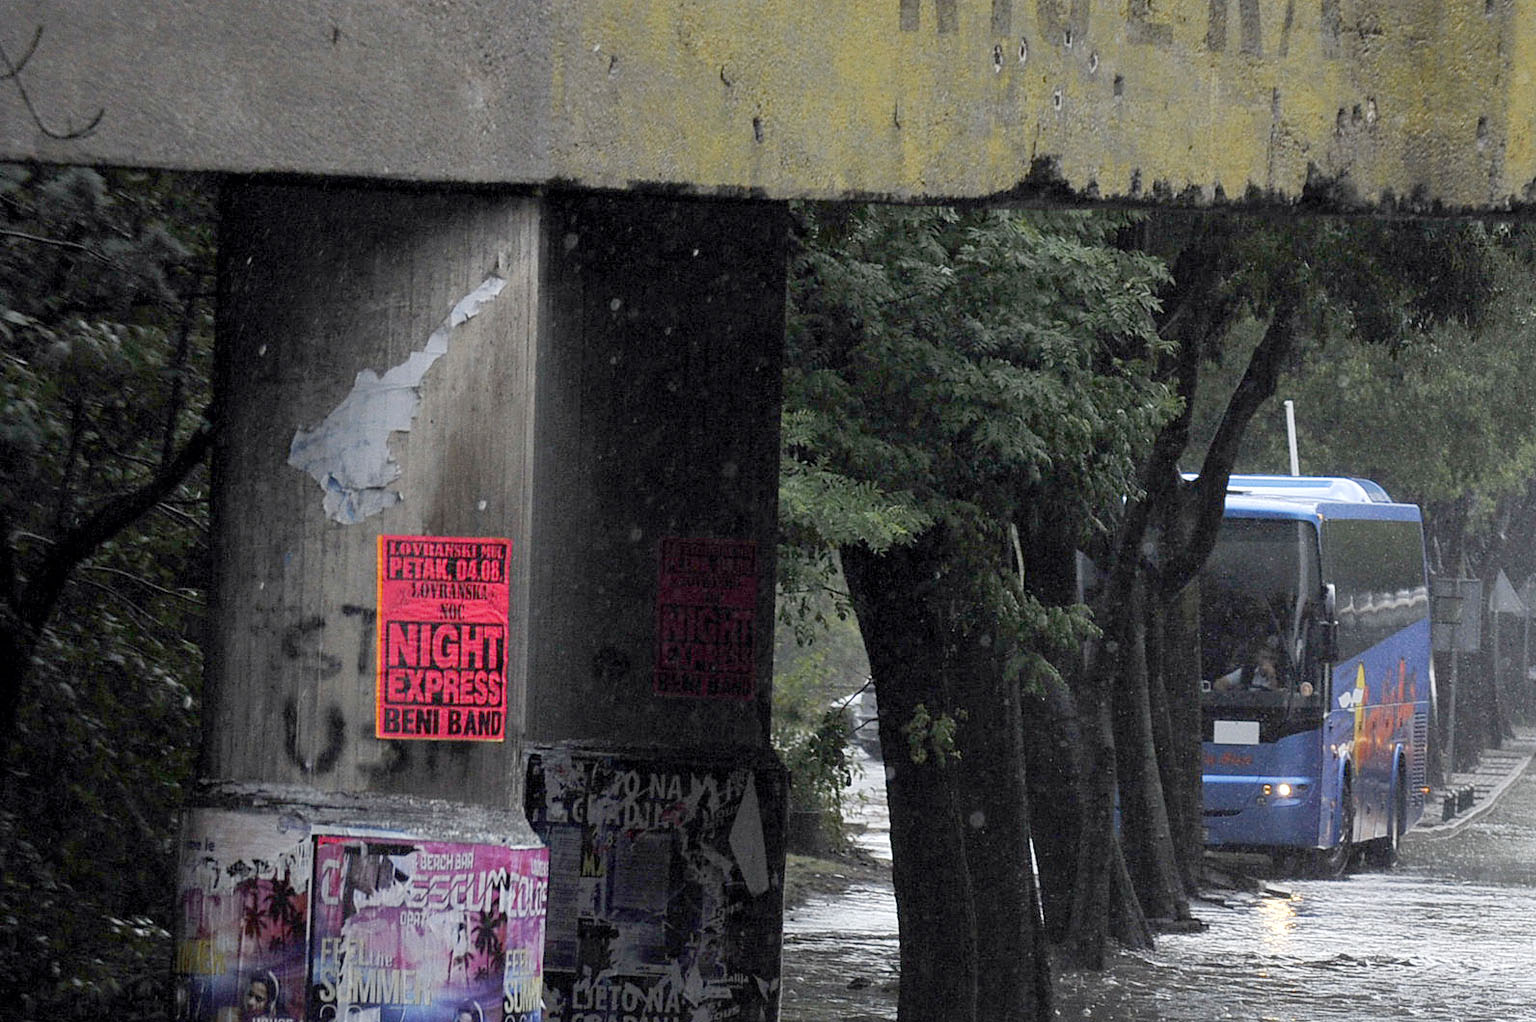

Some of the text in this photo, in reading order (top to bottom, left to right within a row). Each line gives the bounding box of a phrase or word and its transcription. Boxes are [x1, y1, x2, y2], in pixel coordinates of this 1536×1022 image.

[390, 541, 477, 557] LOVRANSKI
[411, 583, 488, 600] LOVRANSKA
[389, 623, 502, 668] NIGHT
[388, 669, 500, 705] EXPRESS
[384, 708, 501, 735] BENI BAND
[421, 852, 453, 871] BEACH
[319, 969, 432, 1006] SUMMER
